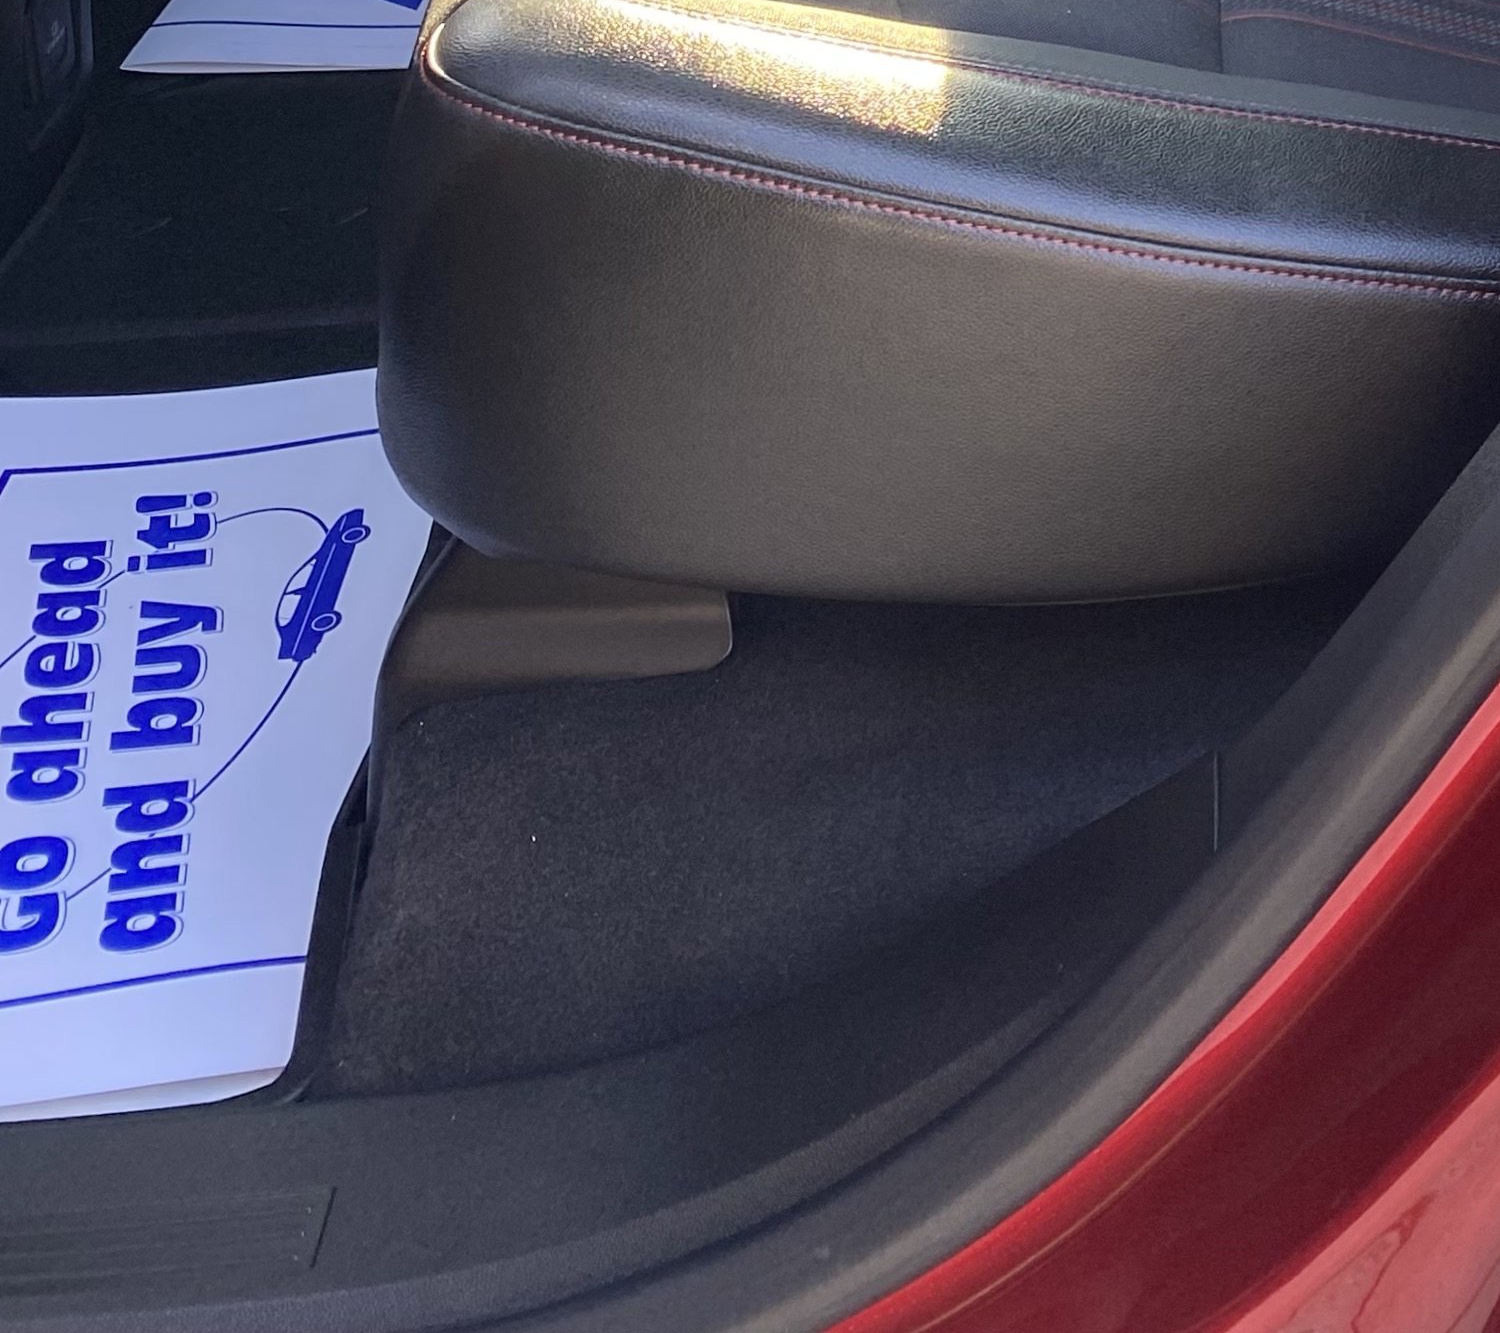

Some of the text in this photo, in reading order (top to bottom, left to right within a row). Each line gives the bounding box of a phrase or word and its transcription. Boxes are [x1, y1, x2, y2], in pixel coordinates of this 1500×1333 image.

[0, 539, 114, 955] Go ahead
[98, 490, 225, 955] and buy it!
